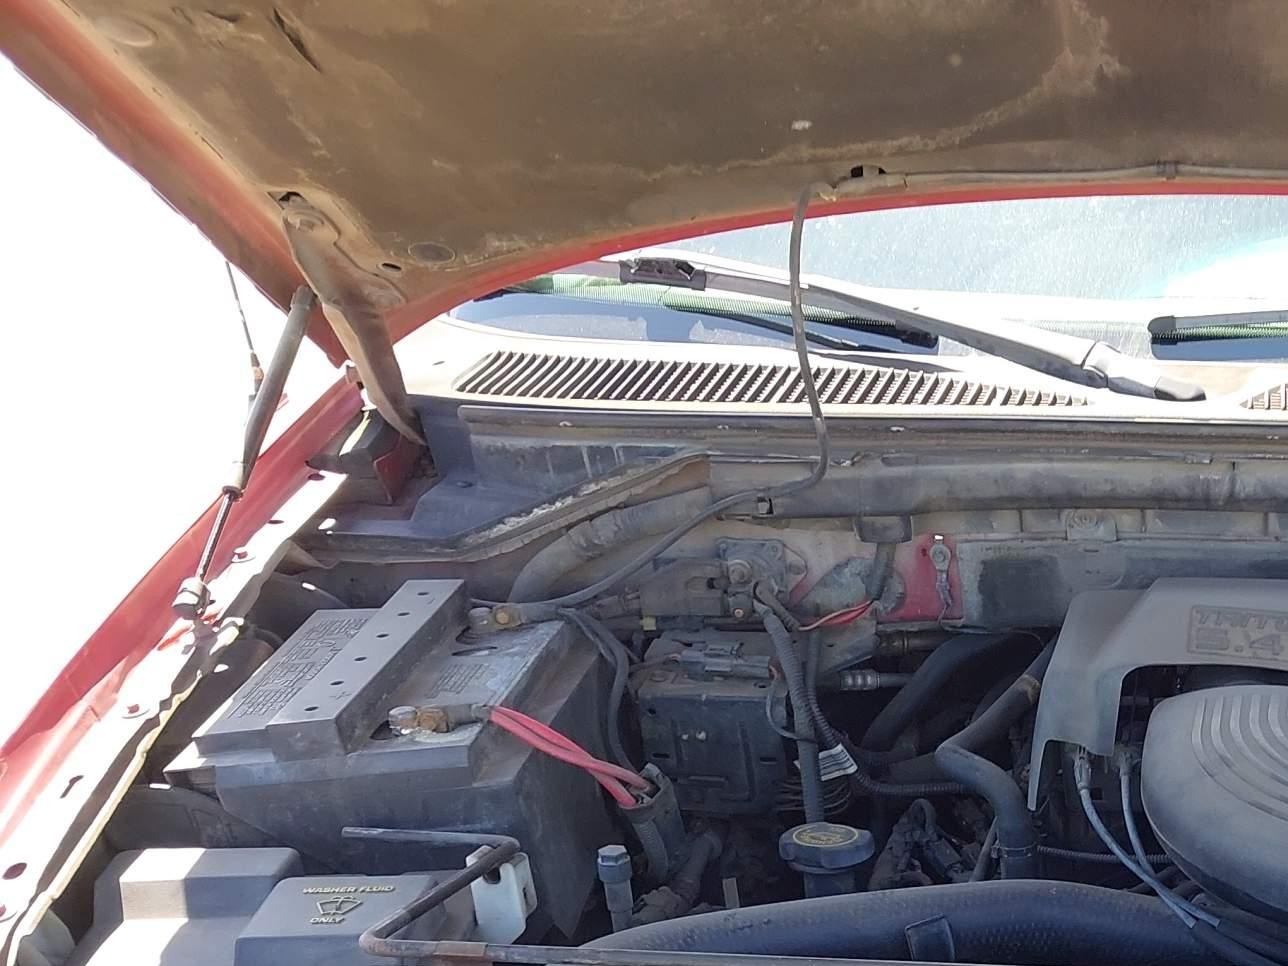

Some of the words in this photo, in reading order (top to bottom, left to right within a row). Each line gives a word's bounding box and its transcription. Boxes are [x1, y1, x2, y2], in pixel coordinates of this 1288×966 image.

[302, 886, 357, 894] WASHER
[359, 885, 396, 893] FLUID
[309, 916, 345, 925] ONLY
